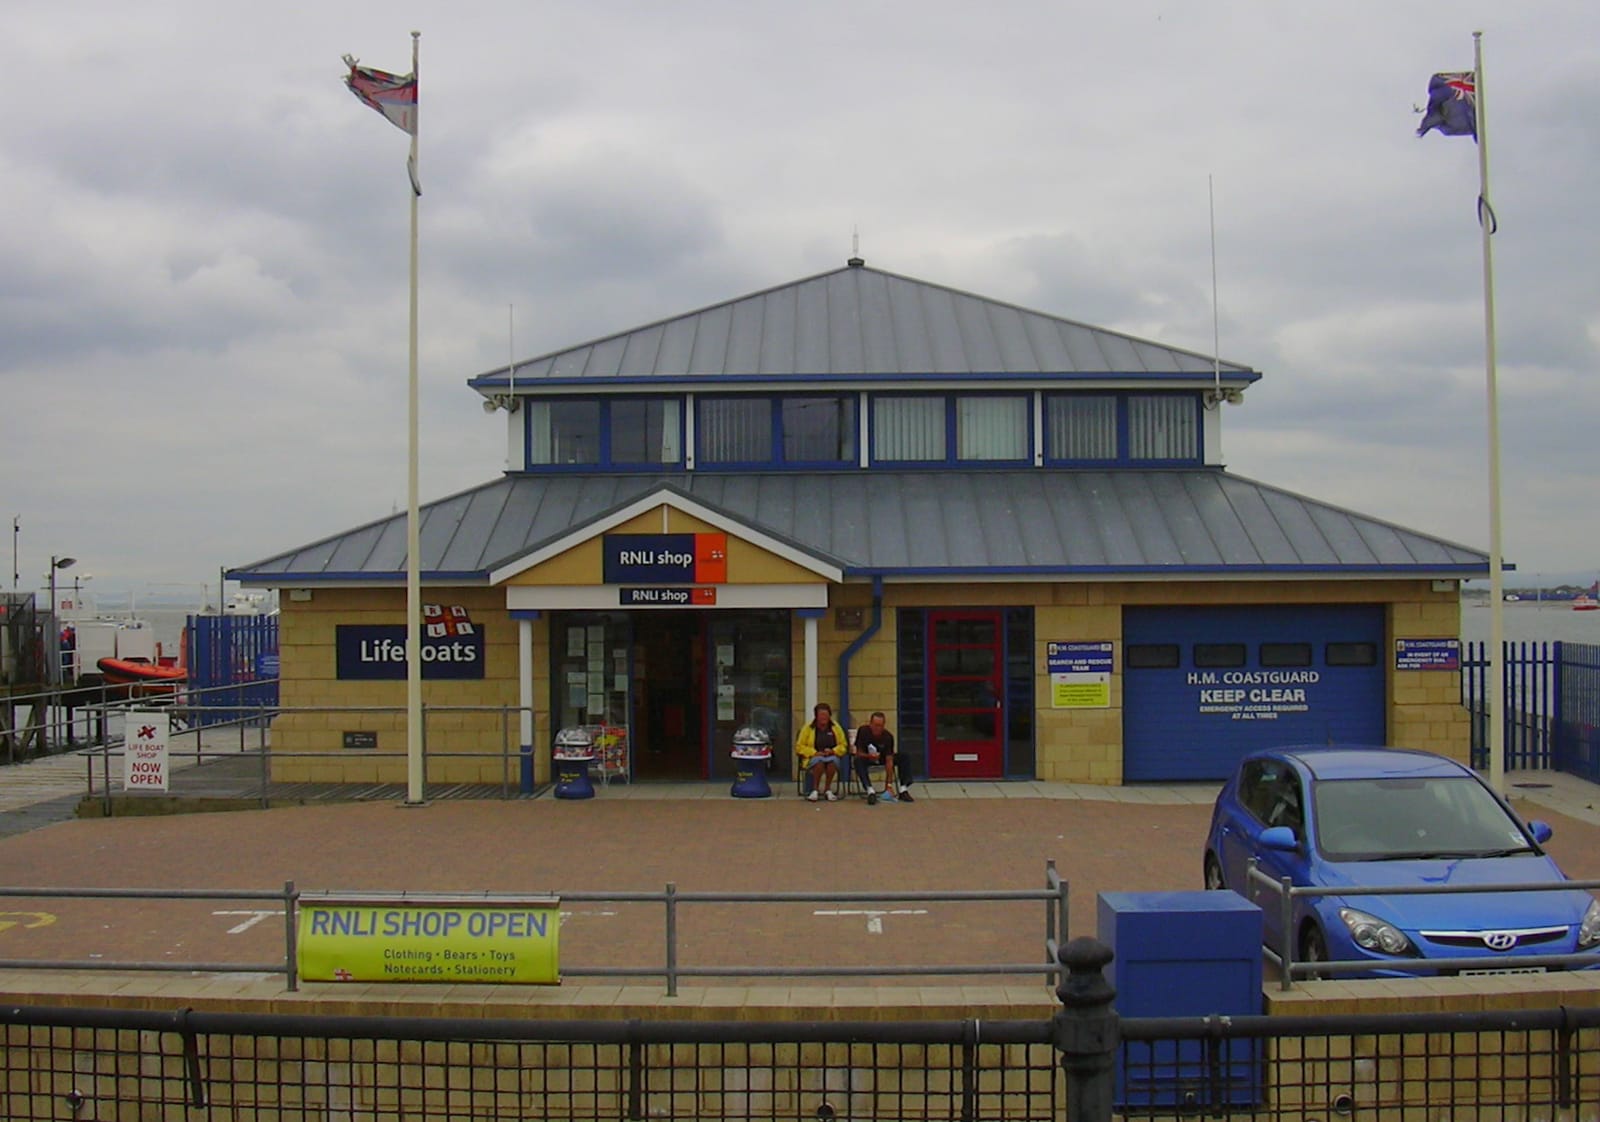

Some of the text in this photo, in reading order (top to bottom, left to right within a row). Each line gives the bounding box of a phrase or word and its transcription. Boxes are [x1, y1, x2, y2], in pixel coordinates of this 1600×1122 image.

[620, 550, 693, 568] RNLI shop
[632, 590, 688, 603] RNLI shop
[360, 639, 476, 662] Lifeoats
[1187, 671, 1320, 684] H.M. COASTGUARD
[1200, 689, 1306, 703] KEEP CLEAR
[1199, 705, 1243, 713] EMERGENCY
[1272, 704, 1309, 712] REQUIRED
[132, 762, 162, 773] NOW
[130, 774, 162, 785] OPEN
[311, 910, 547, 938] RNLI SHOP OPEN
[384, 949, 516, 962] Clothing Bears Toys
[384, 963, 516, 976] Notecards Stationery
